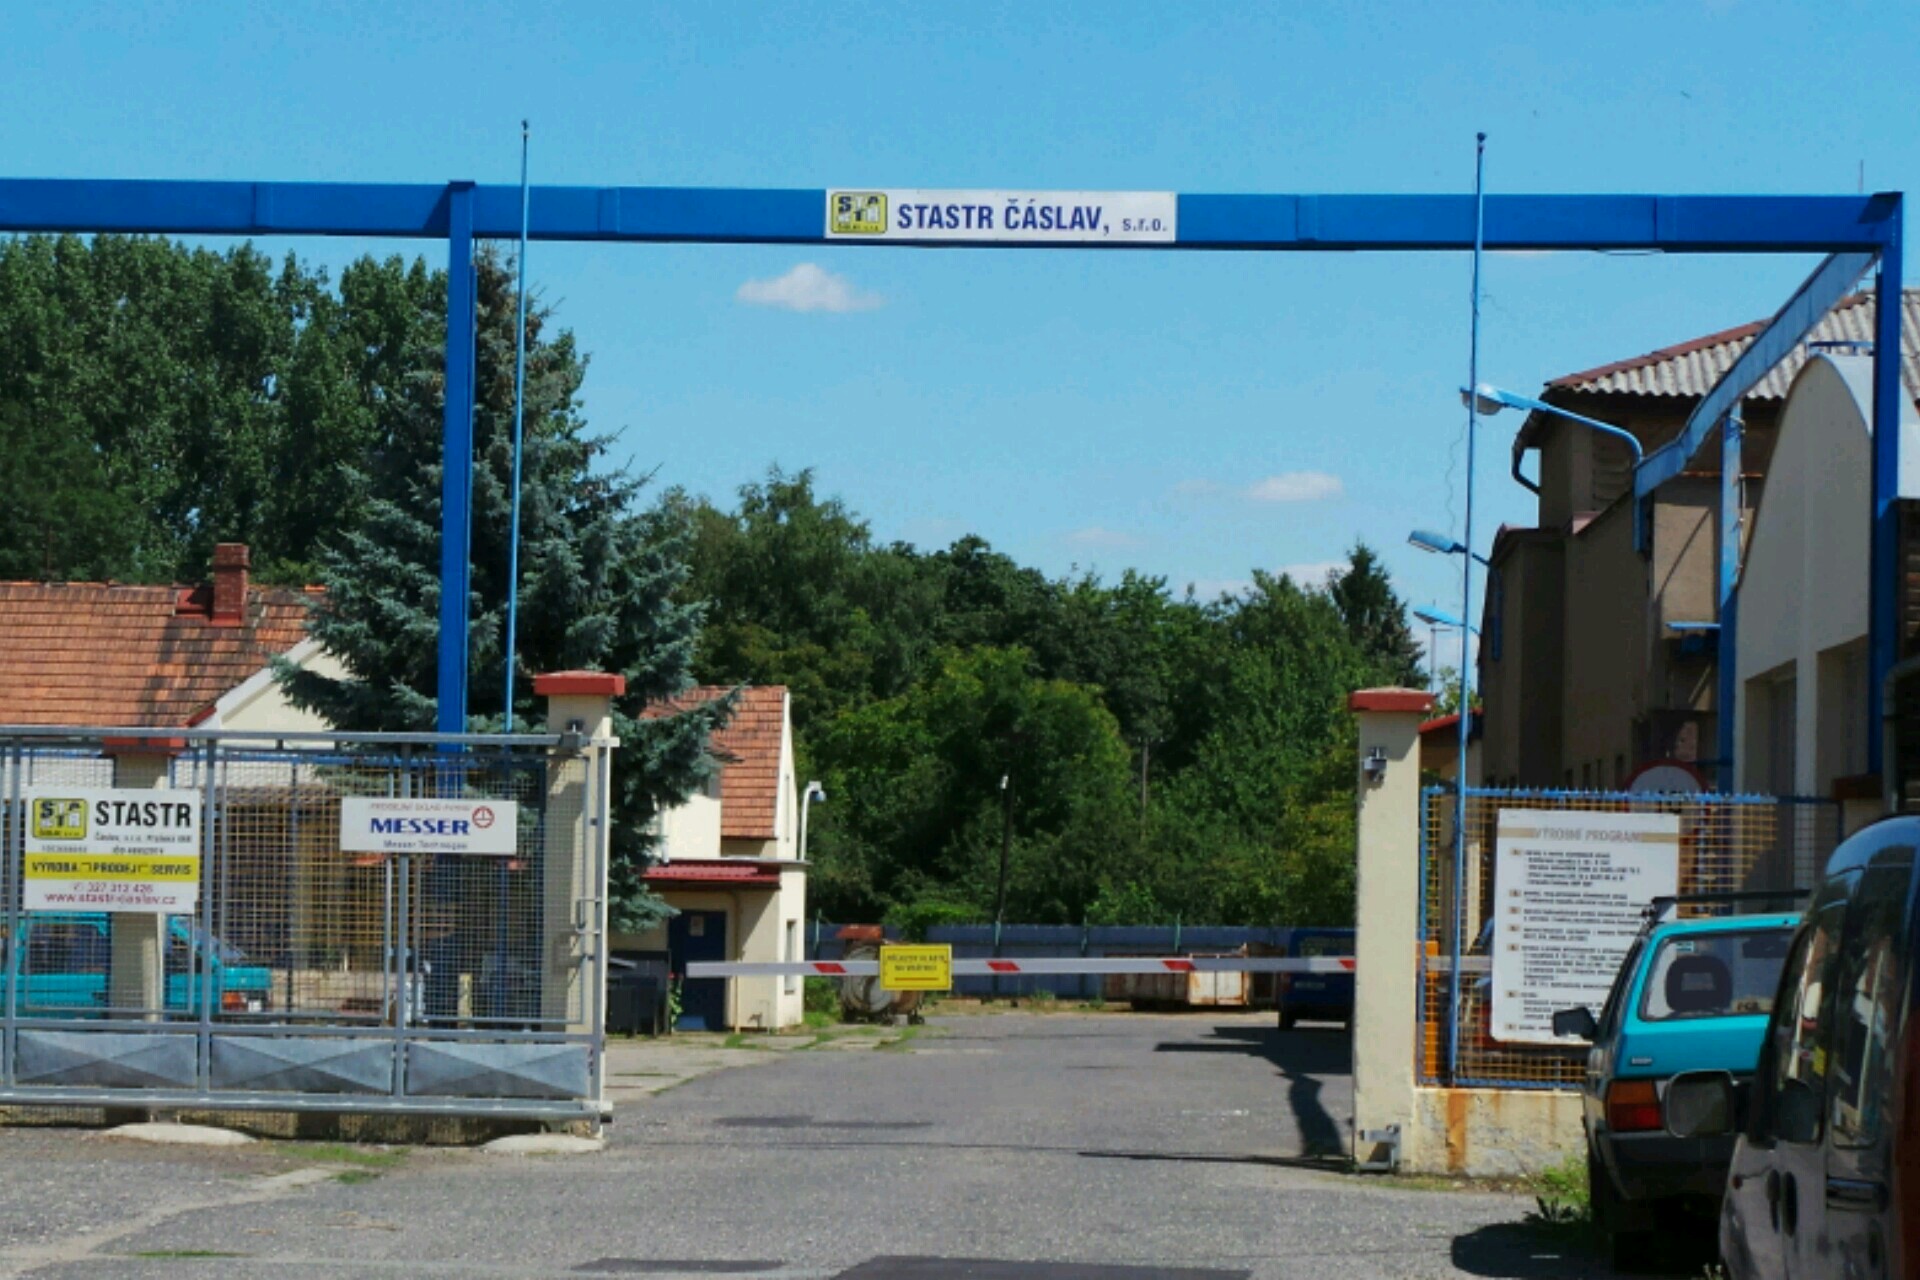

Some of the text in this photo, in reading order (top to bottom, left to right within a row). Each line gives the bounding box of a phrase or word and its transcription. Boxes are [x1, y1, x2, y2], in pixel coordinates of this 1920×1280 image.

[897, 198, 1168, 235] STASTR ČÁSLAV, s.r.o.
[95, 801, 191, 827] STASTR
[370, 818, 470, 835] MESSER
